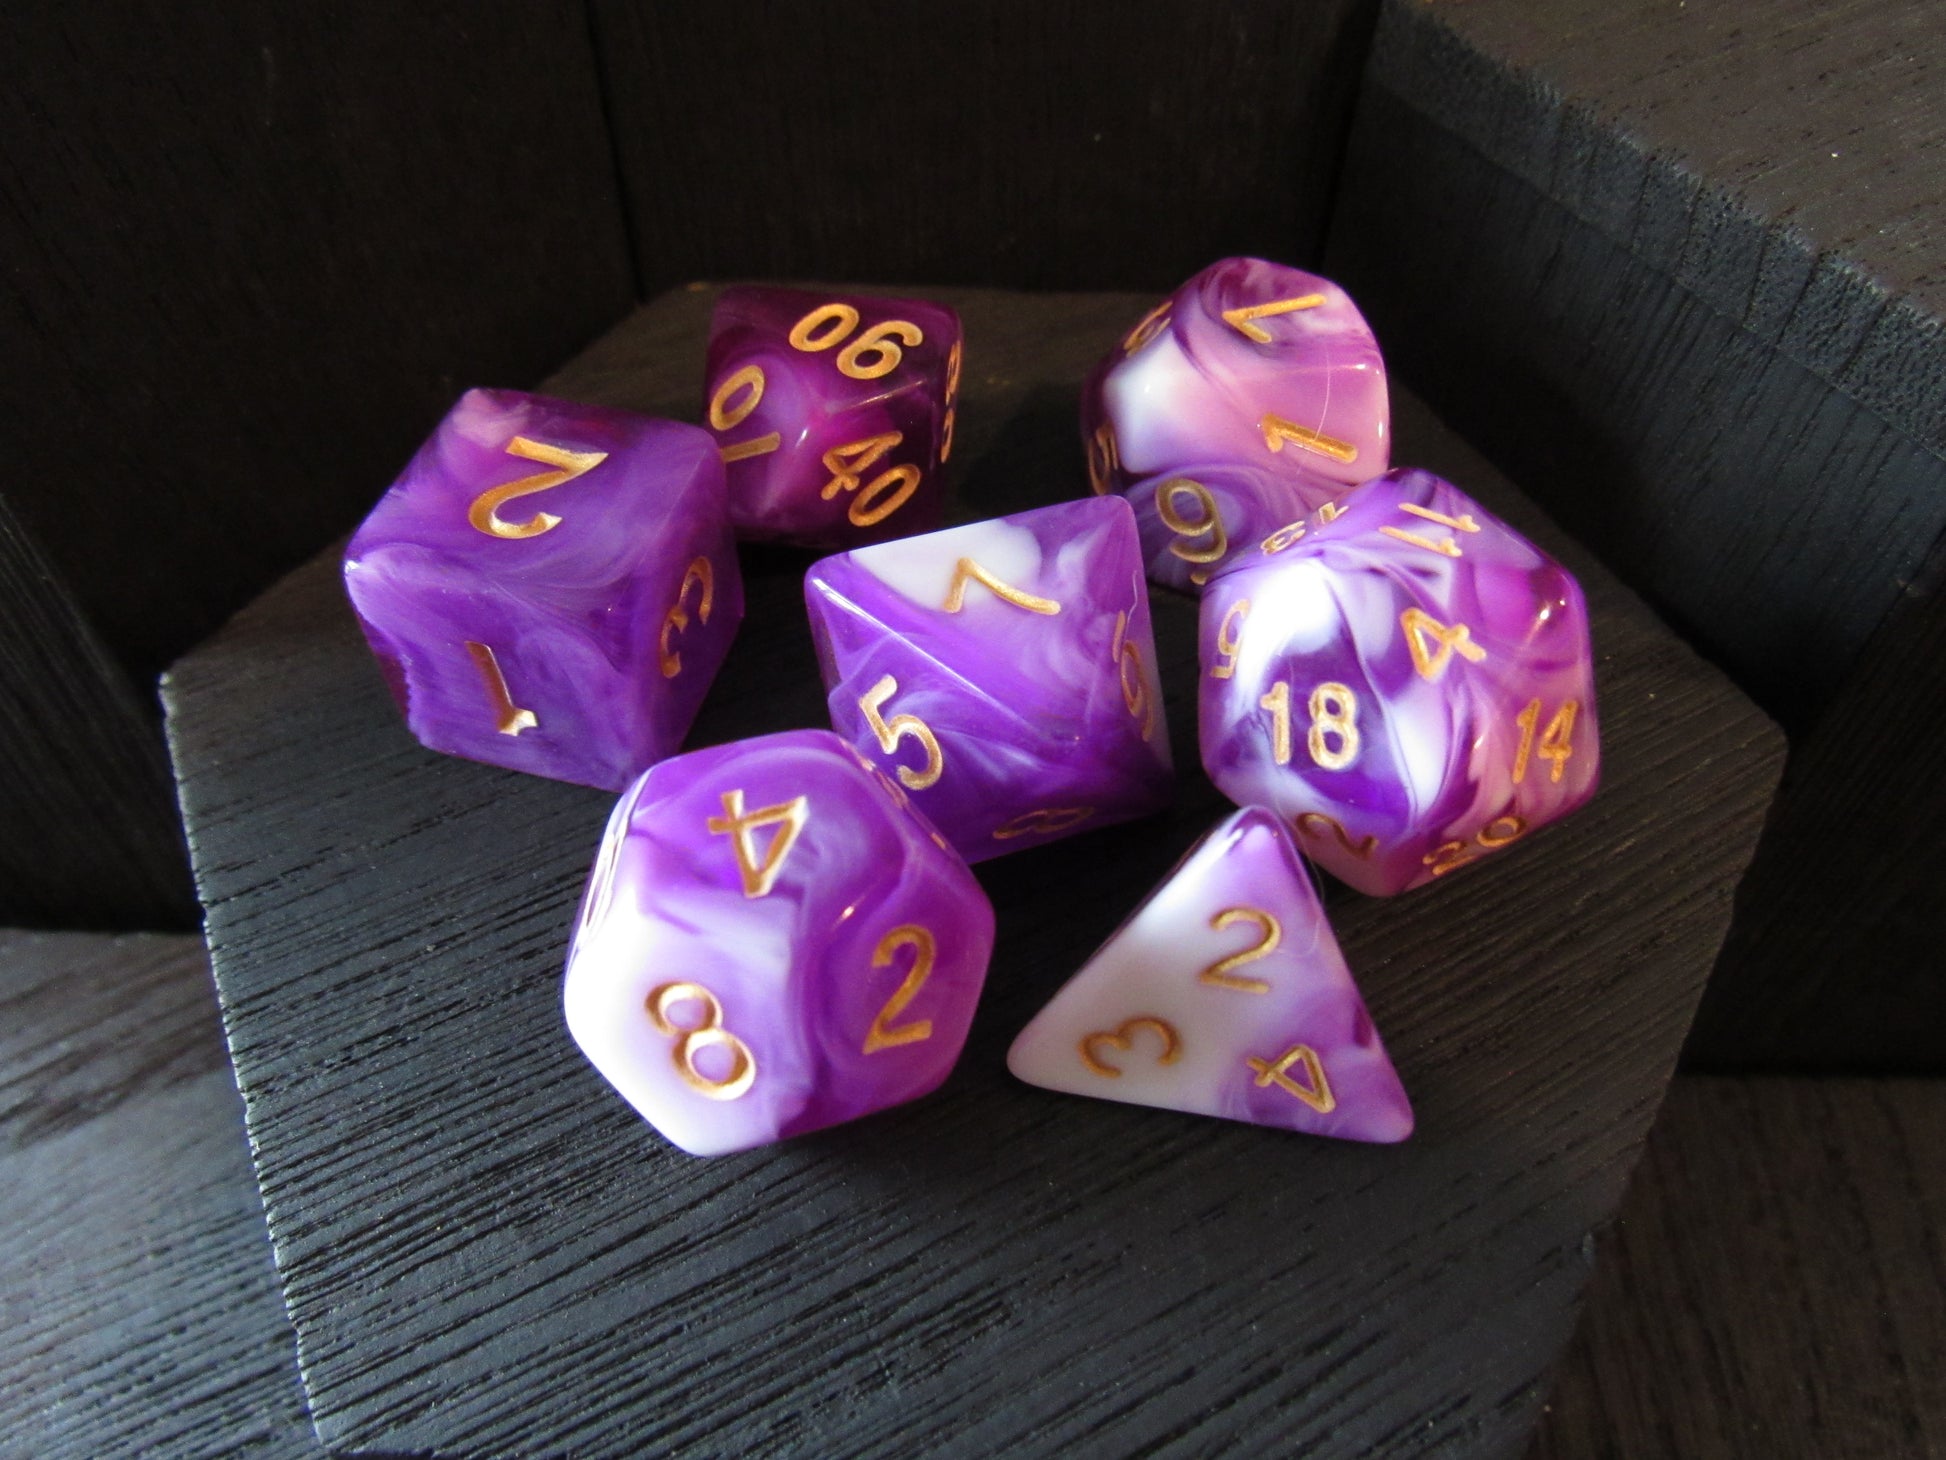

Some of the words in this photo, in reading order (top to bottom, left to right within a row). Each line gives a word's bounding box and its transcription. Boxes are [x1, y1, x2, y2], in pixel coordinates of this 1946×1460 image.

[820, 431, 921, 528] 40
[1260, 412, 1359, 464] 1
[467, 435, 610, 540] 2
[1378, 502, 1482, 558] 11
[660, 556, 714, 679] 3
[943, 555, 1062, 616] 7
[1210, 598, 1250, 680] 5
[1399, 606, 1488, 682] 4
[464, 640, 538, 737] 1
[858, 673, 944, 791] 5
[1260, 680, 1361, 770] 18
[1511, 697, 1580, 784] 14
[707, 788, 810, 900] 4
[862, 923, 938, 1055] 2
[1198, 906, 1284, 995] 2
[643, 981, 758, 1103] 8
[1077, 1015, 1184, 1080] 3
[1246, 1042, 1337, 1115] 4
